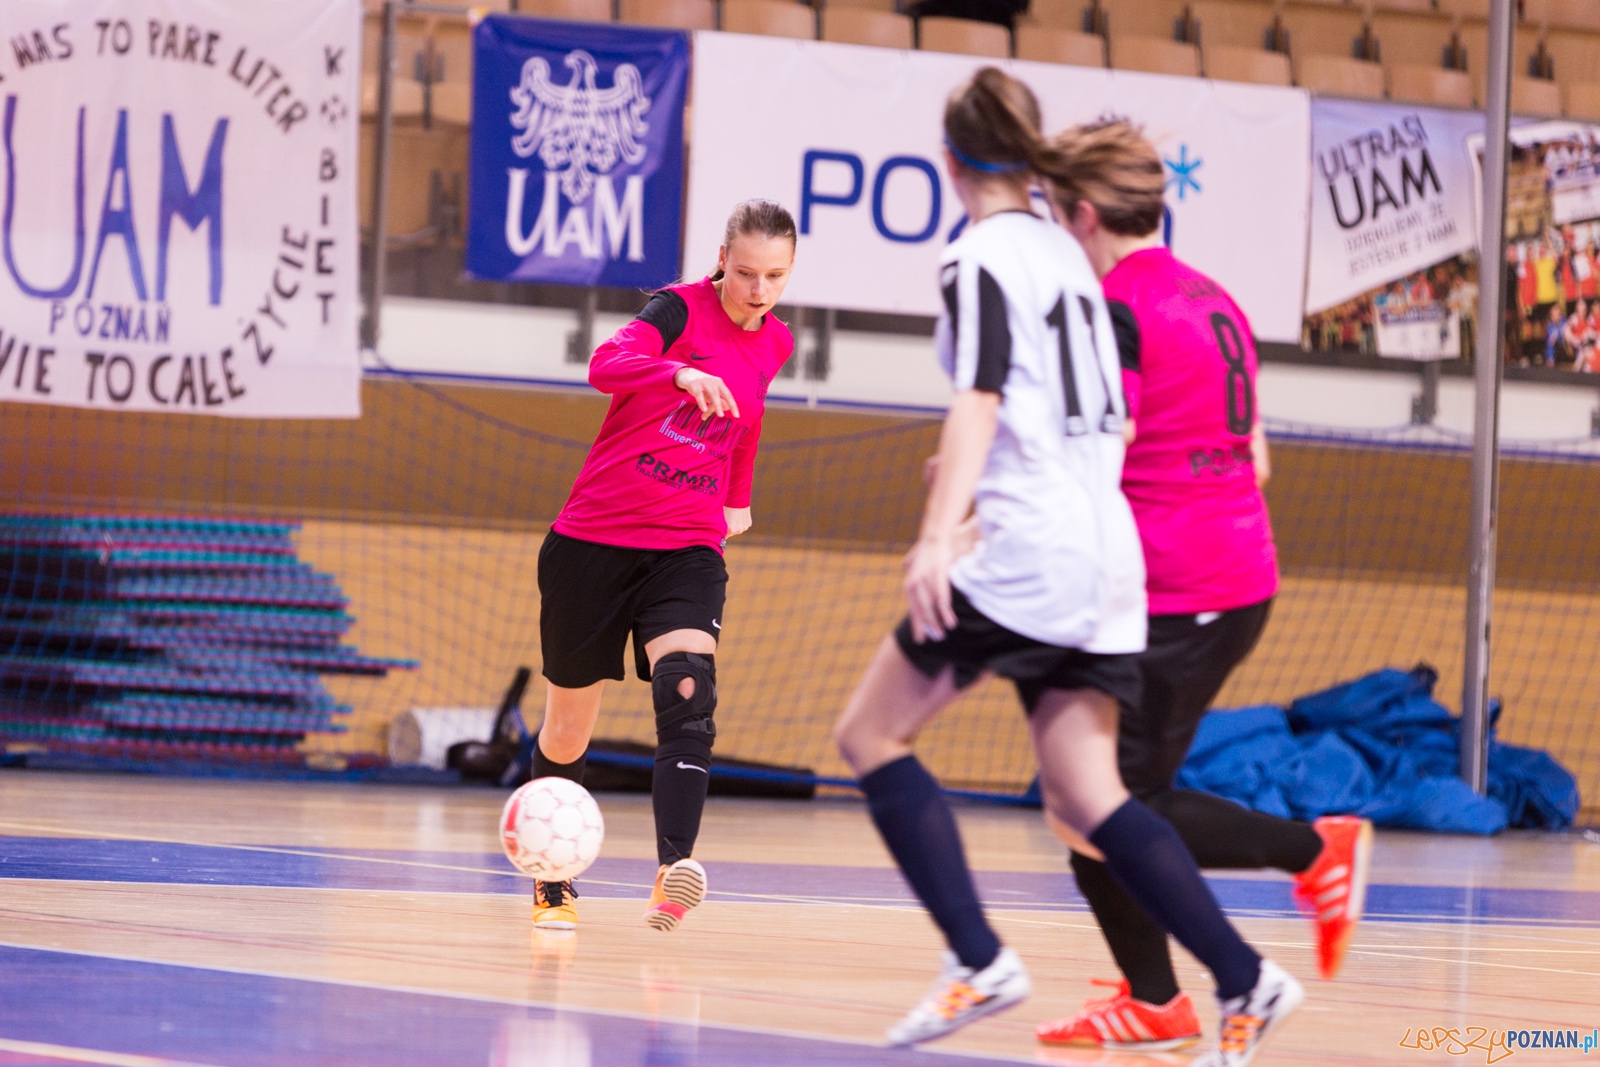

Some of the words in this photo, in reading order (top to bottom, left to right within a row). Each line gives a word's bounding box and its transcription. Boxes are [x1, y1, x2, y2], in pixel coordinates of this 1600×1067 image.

[95, 19, 133, 56] TO
[229, 46, 309, 134] LITER
[1317, 113, 1429, 181] ULTRASI
[1328, 147, 1442, 230] UAM
[2, 94, 231, 306] UAM
[505, 167, 644, 262] UAM
[86, 352, 135, 403] TO
[148, 348, 246, 405] CAŁE
[1209, 311, 1253, 435] 8
